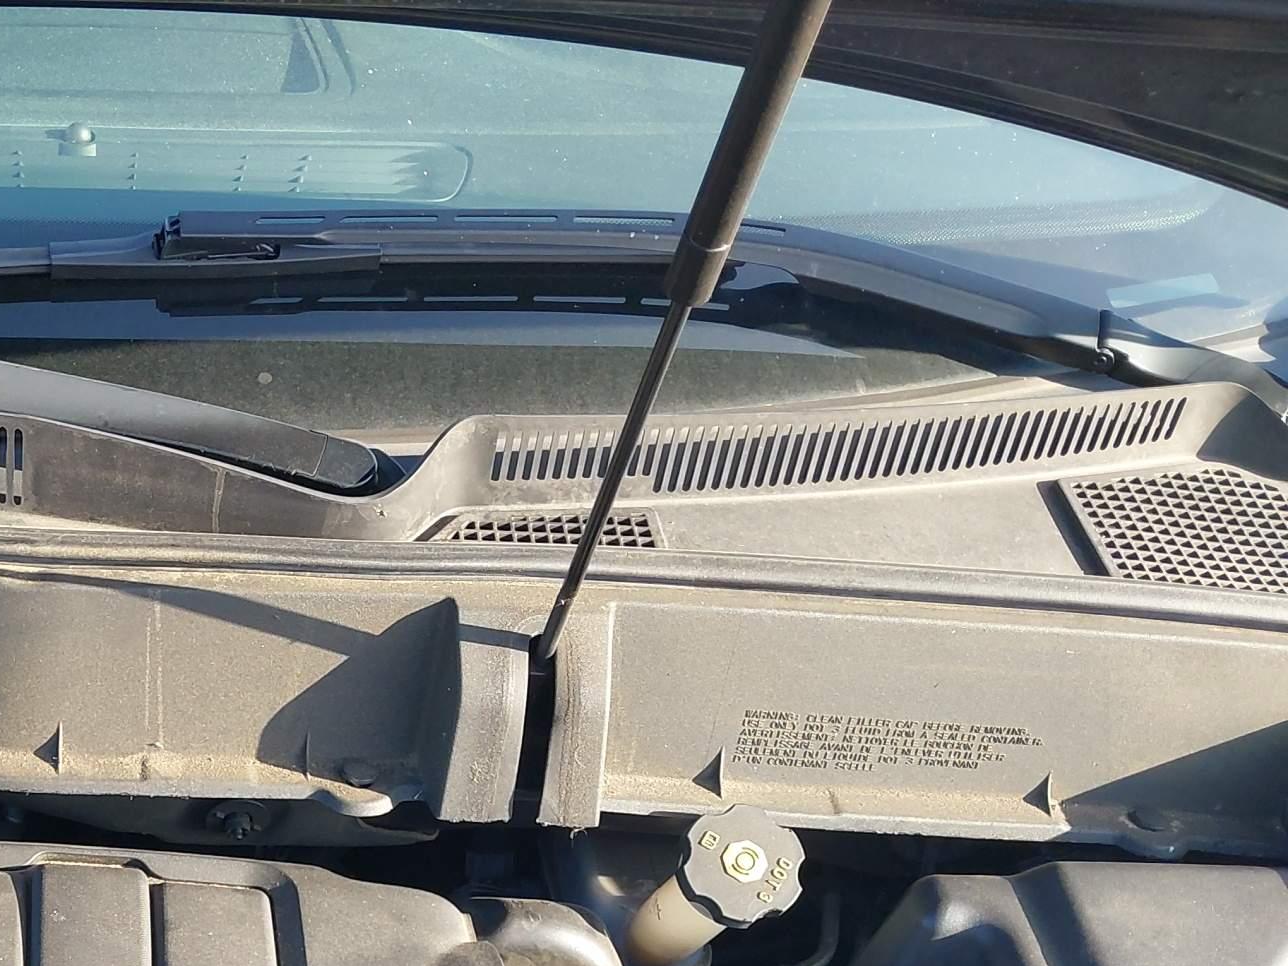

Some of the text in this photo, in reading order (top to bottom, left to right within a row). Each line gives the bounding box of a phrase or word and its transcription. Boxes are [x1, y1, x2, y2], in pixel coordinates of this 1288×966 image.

[742, 718, 763, 728] USE
[806, 714, 843, 724] CLEAN
[765, 857, 793, 891] DOT
